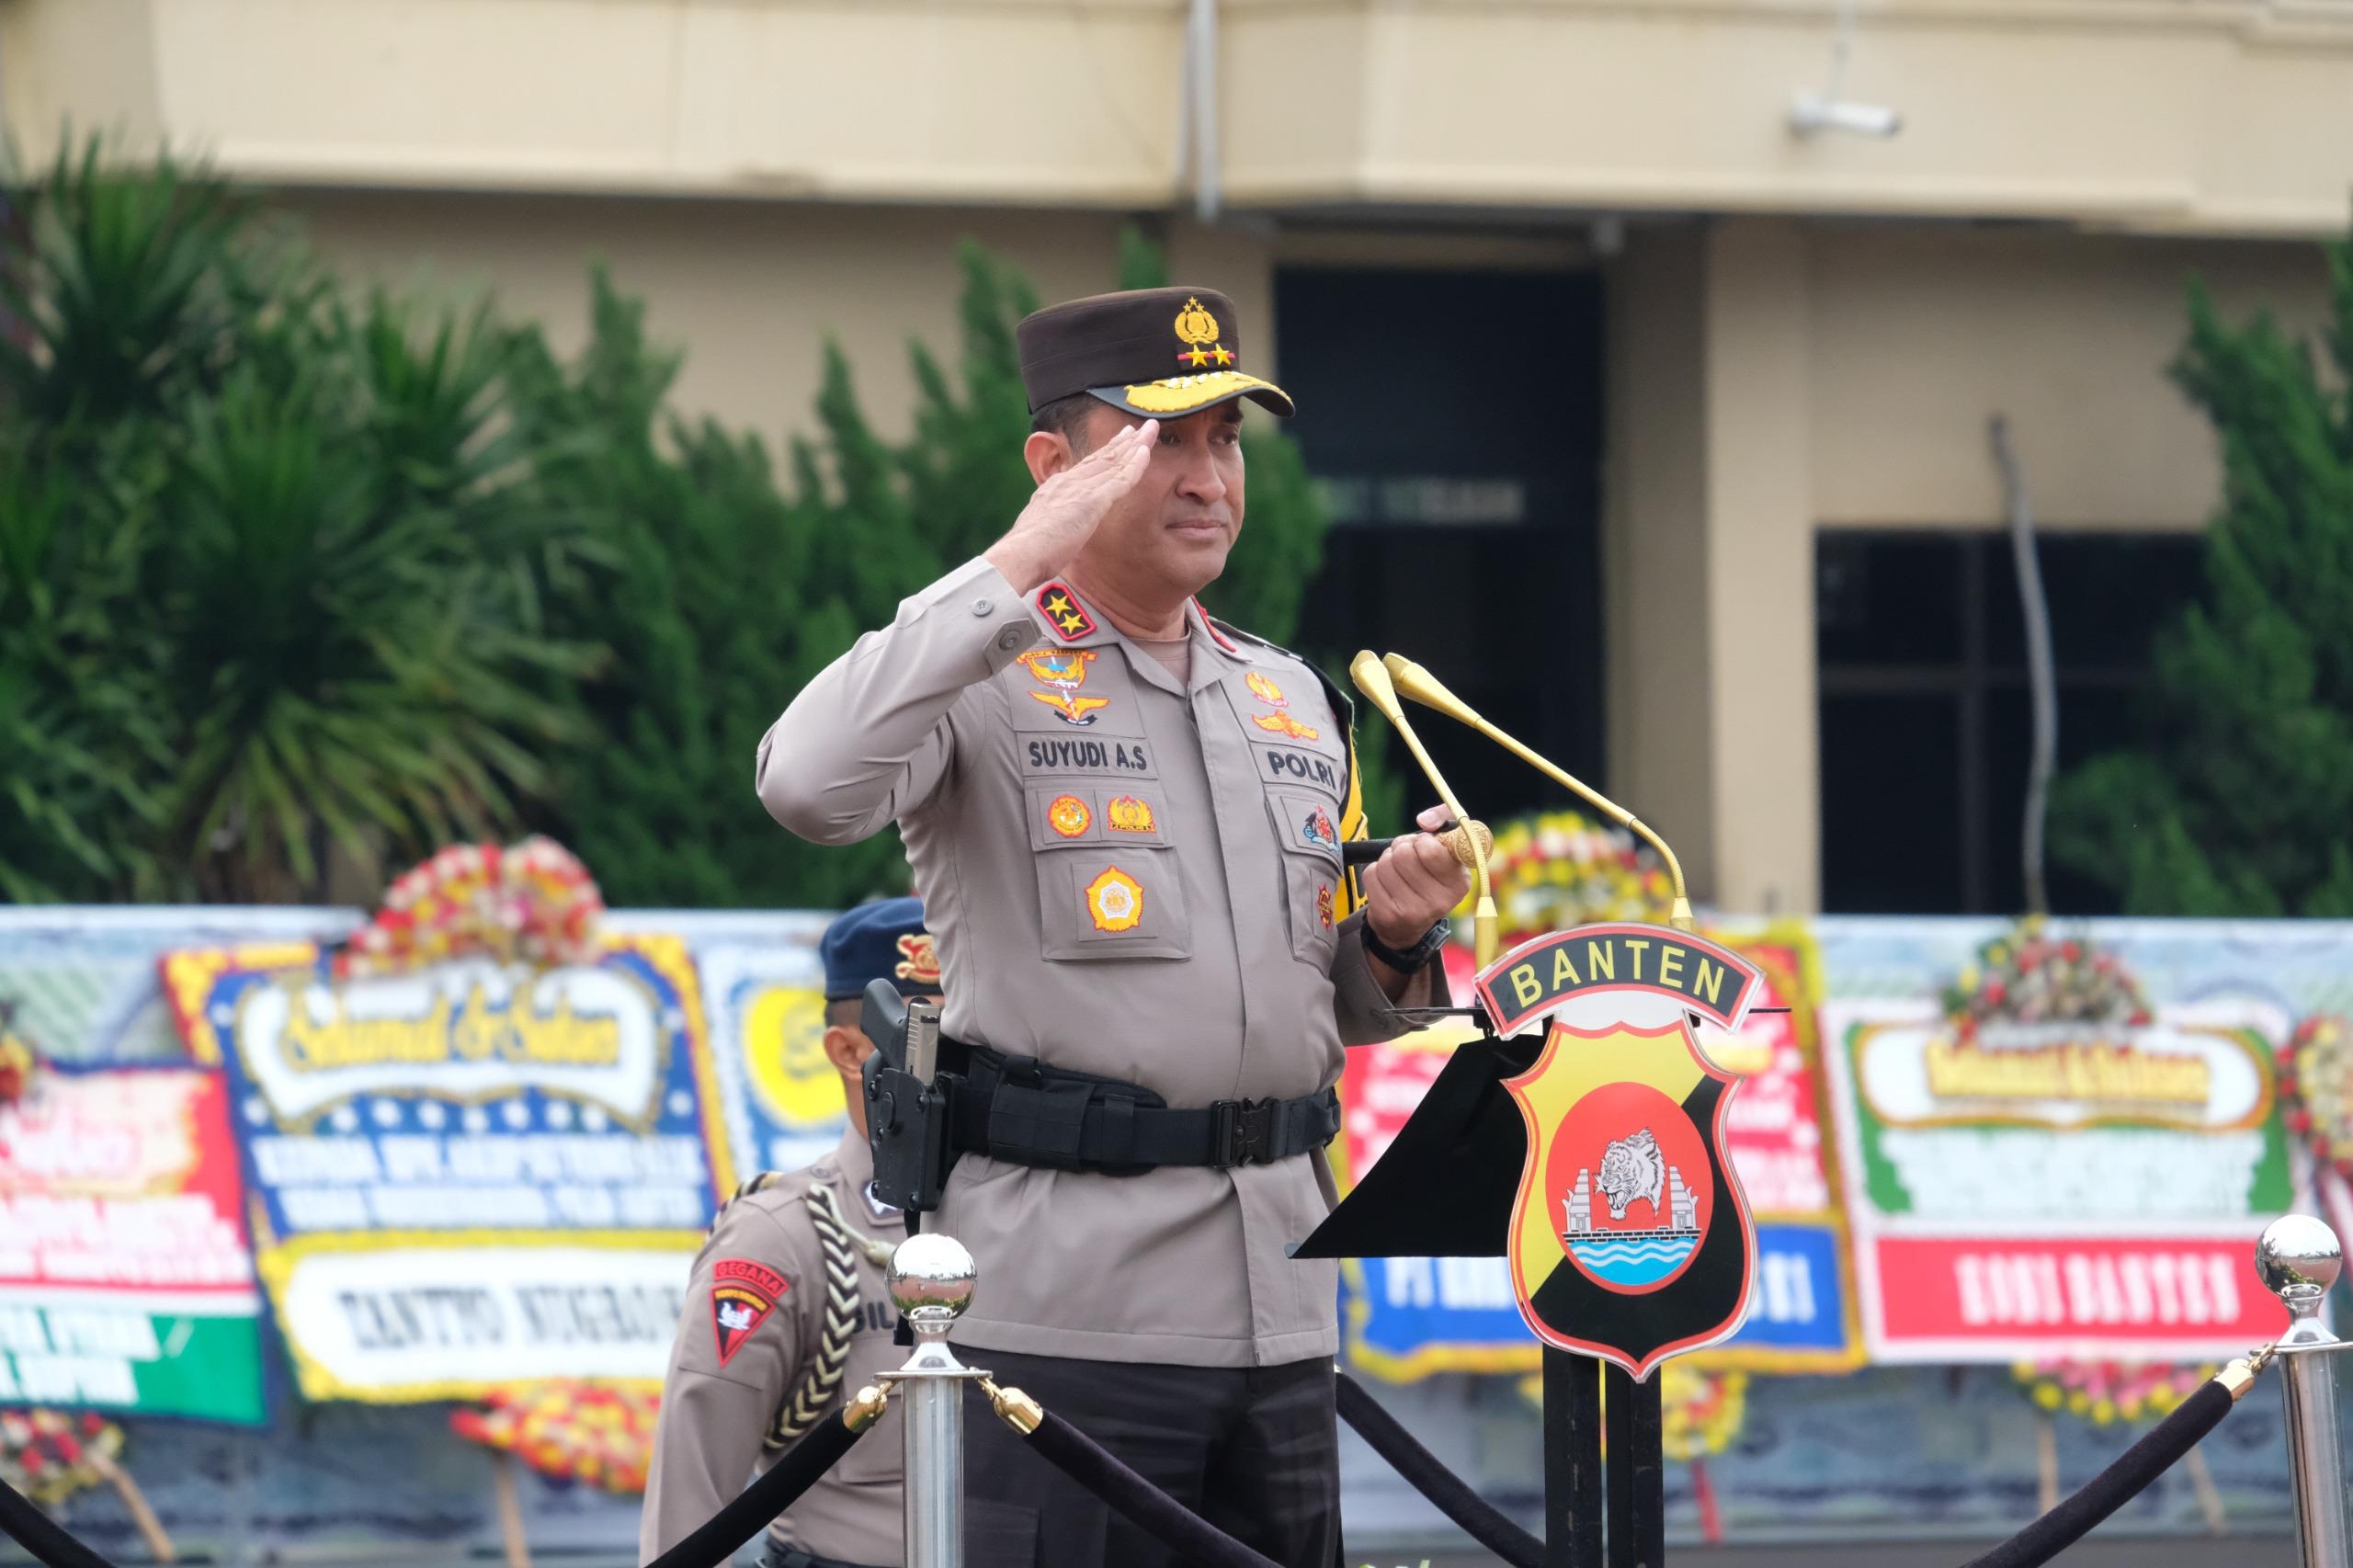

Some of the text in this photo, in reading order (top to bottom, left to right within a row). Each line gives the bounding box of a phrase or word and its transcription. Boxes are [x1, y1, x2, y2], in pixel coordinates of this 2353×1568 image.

[1029, 741, 1148, 771] SUYUDI A.S
[1267, 750, 1336, 790] POLRI
[1509, 939, 1725, 1009] BANTEN
[716, 1262, 781, 1294] GEGANA
